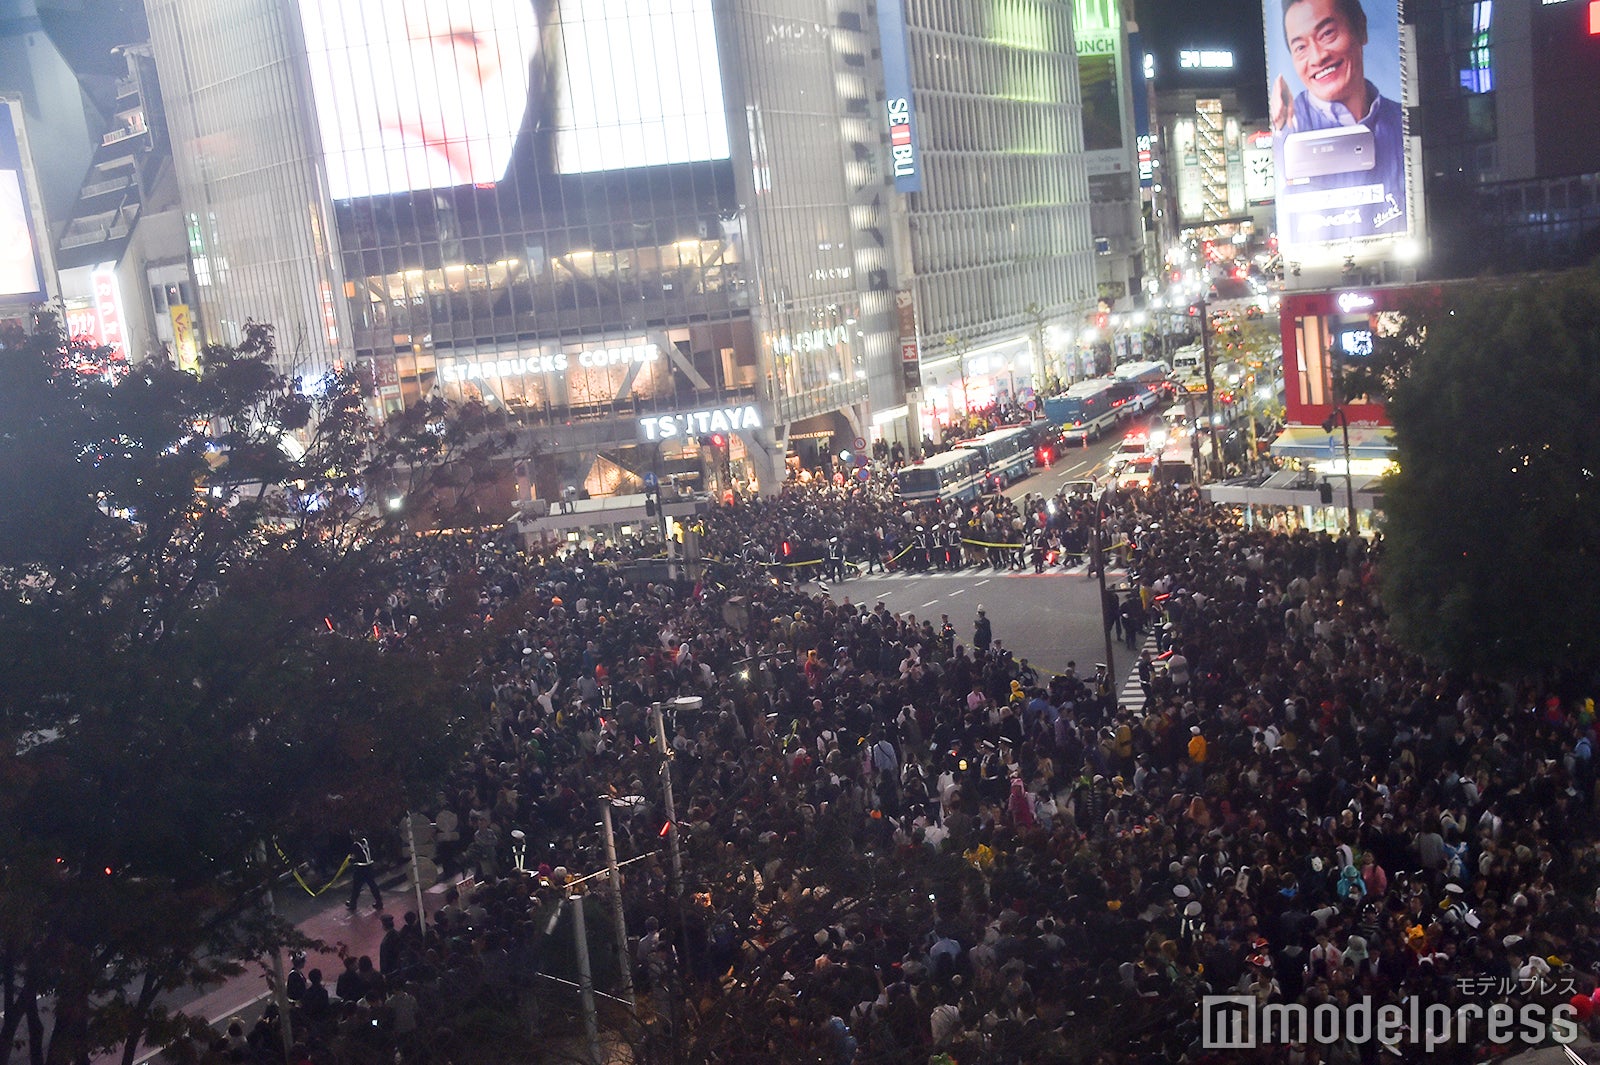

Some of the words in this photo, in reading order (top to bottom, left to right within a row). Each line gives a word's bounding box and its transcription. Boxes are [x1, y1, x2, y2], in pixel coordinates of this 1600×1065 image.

[887, 98, 914, 177] SEIBU
[442, 354, 568, 382] STARBUCKS
[578, 343, 659, 368] COFFEE
